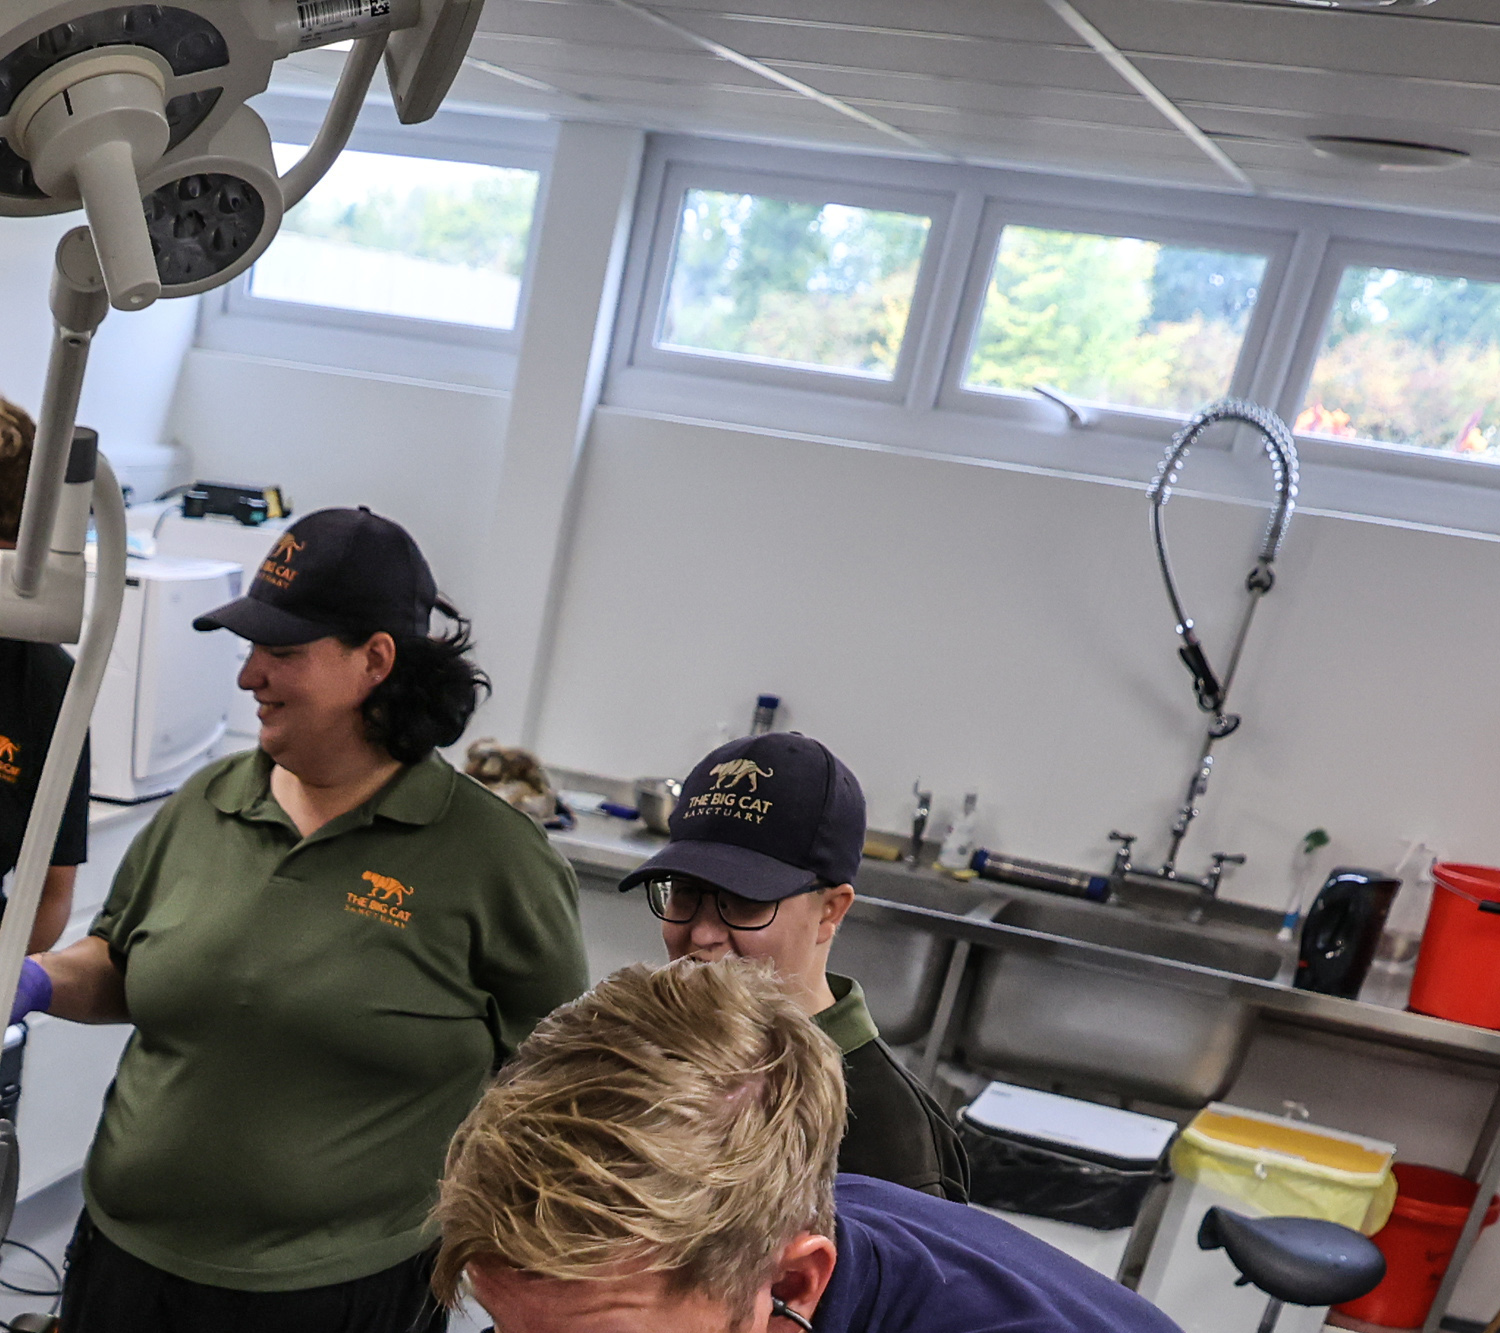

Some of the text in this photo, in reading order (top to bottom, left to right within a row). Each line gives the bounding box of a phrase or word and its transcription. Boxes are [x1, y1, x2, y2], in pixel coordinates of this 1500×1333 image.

[688, 791, 773, 814] THE BIG CAT
[682, 806, 764, 825] SANCTUARY
[346, 891, 412, 923] THE BIG CAT
